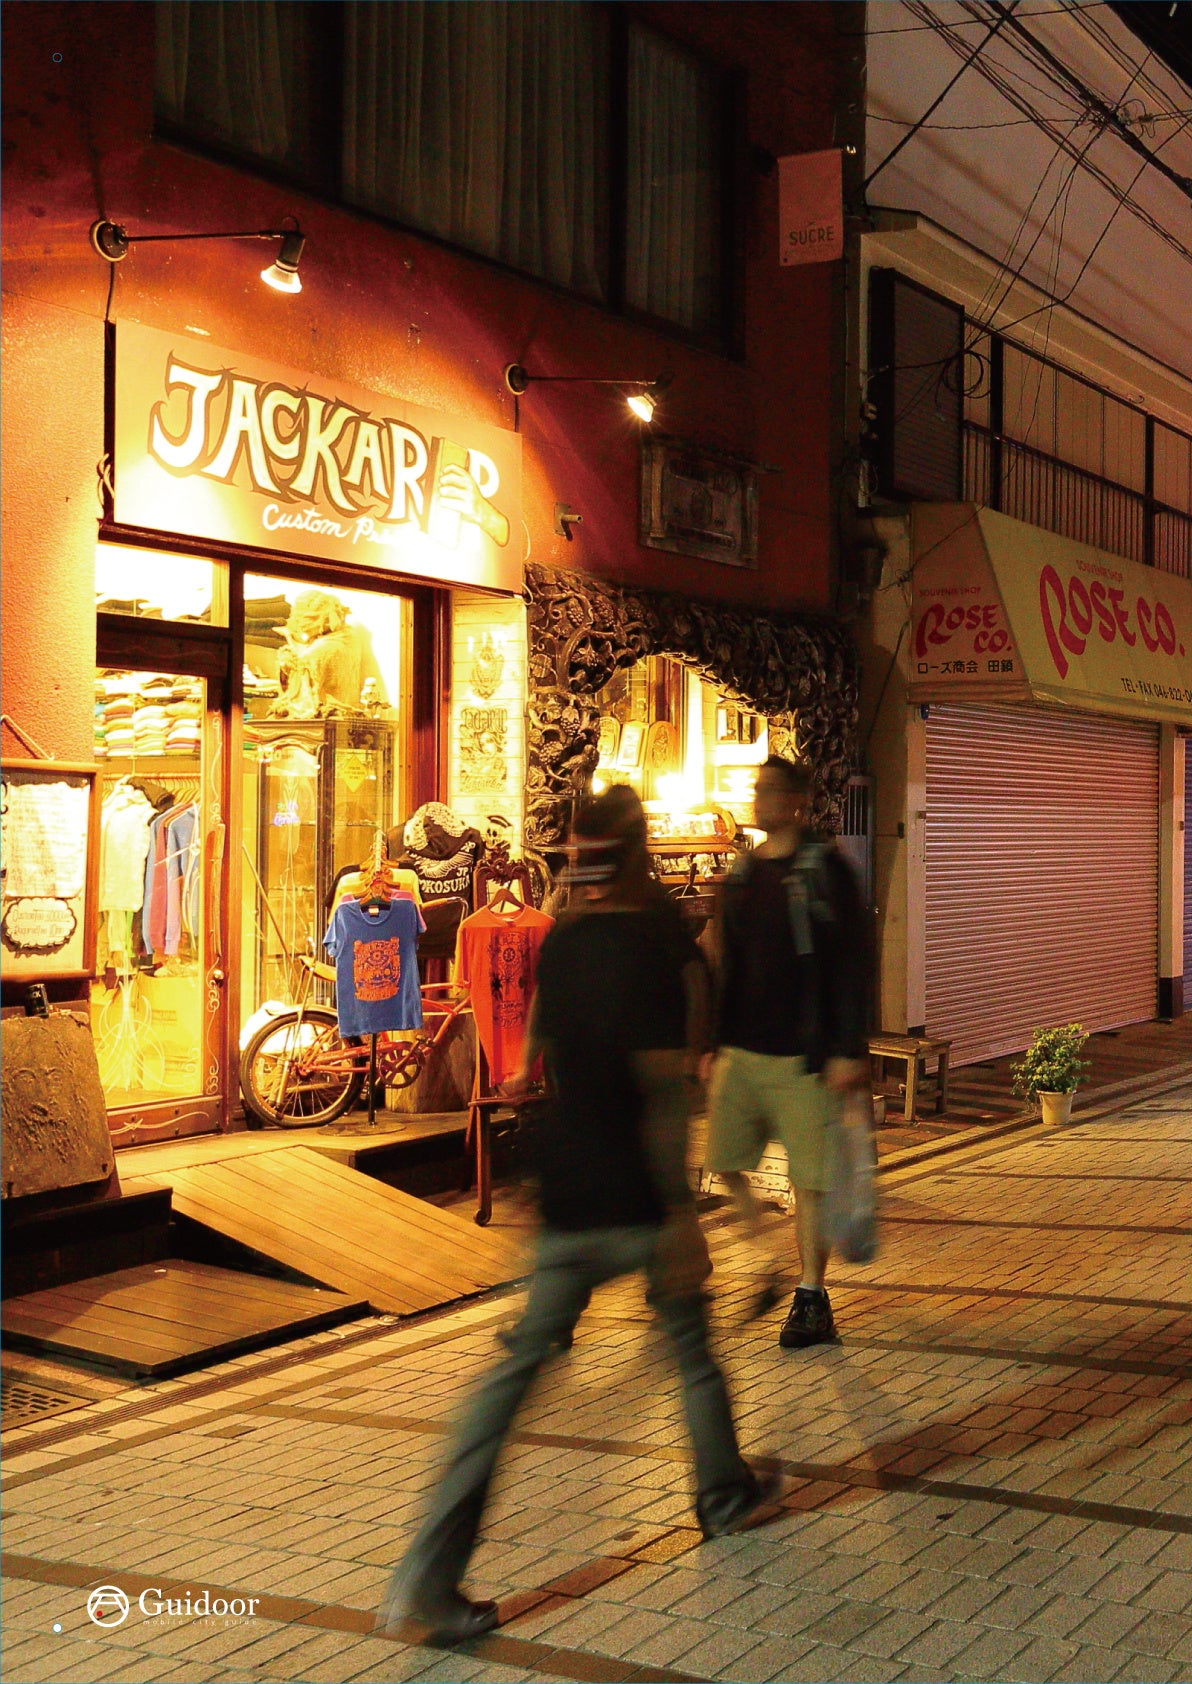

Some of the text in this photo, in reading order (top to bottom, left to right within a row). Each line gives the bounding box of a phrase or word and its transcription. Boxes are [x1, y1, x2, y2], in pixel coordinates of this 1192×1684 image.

[789, 225, 835, 246] SUCRE
[262, 503, 349, 541] Custom
[916, 603, 999, 659] ROSE
[1040, 564, 1186, 680] ROSE CO.
[973, 629, 1013, 654] CO.
[917, 660, 979, 675] ローズ商会
[457, 867, 469, 877] JP
